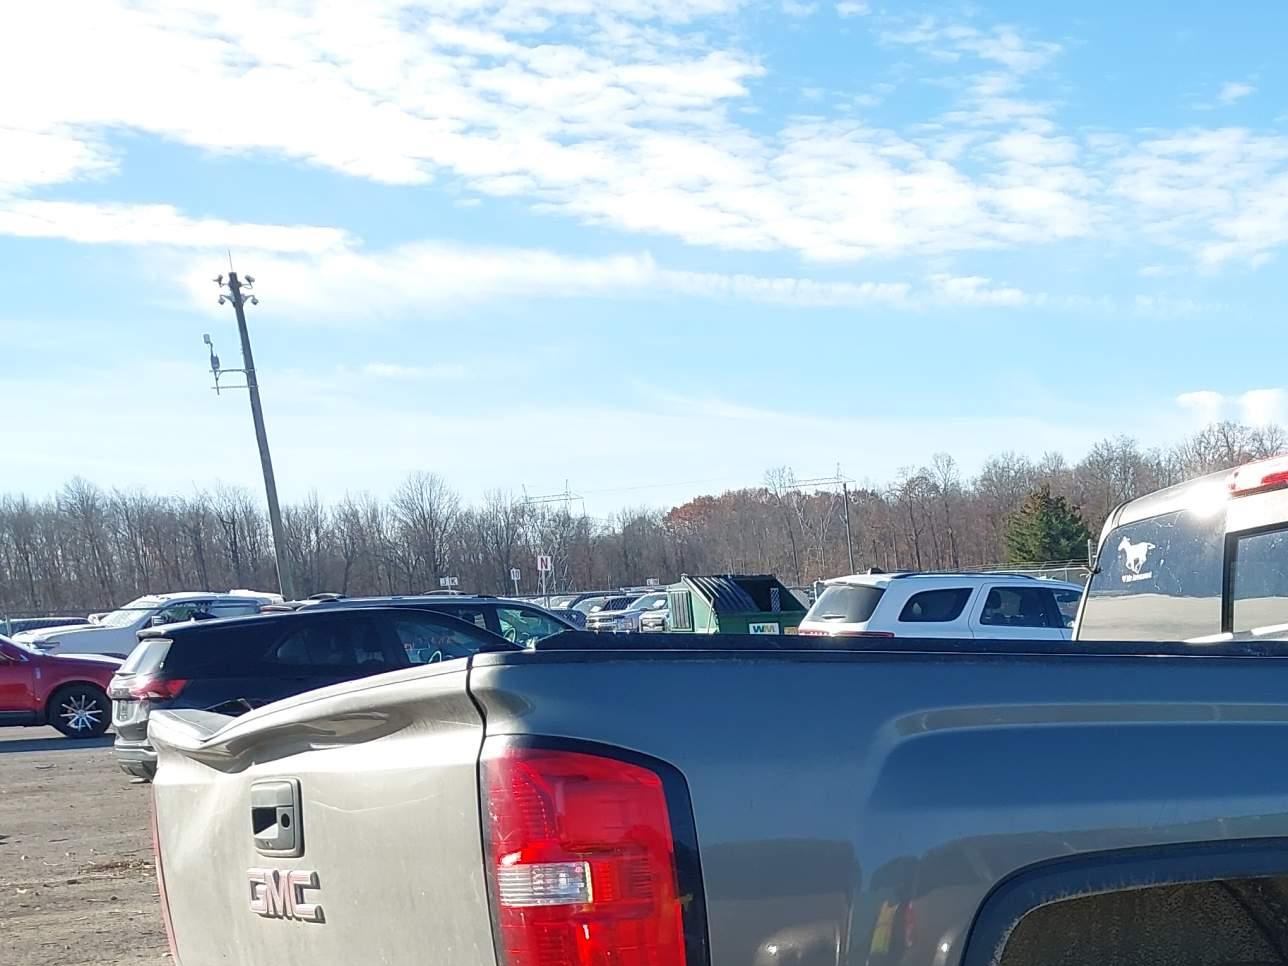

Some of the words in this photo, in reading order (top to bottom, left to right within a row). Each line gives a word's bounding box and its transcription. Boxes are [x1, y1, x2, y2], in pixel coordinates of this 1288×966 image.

[541, 557, 548, 569] N
[752, 625, 776, 633] WM
[246, 867, 326, 924] GMC
